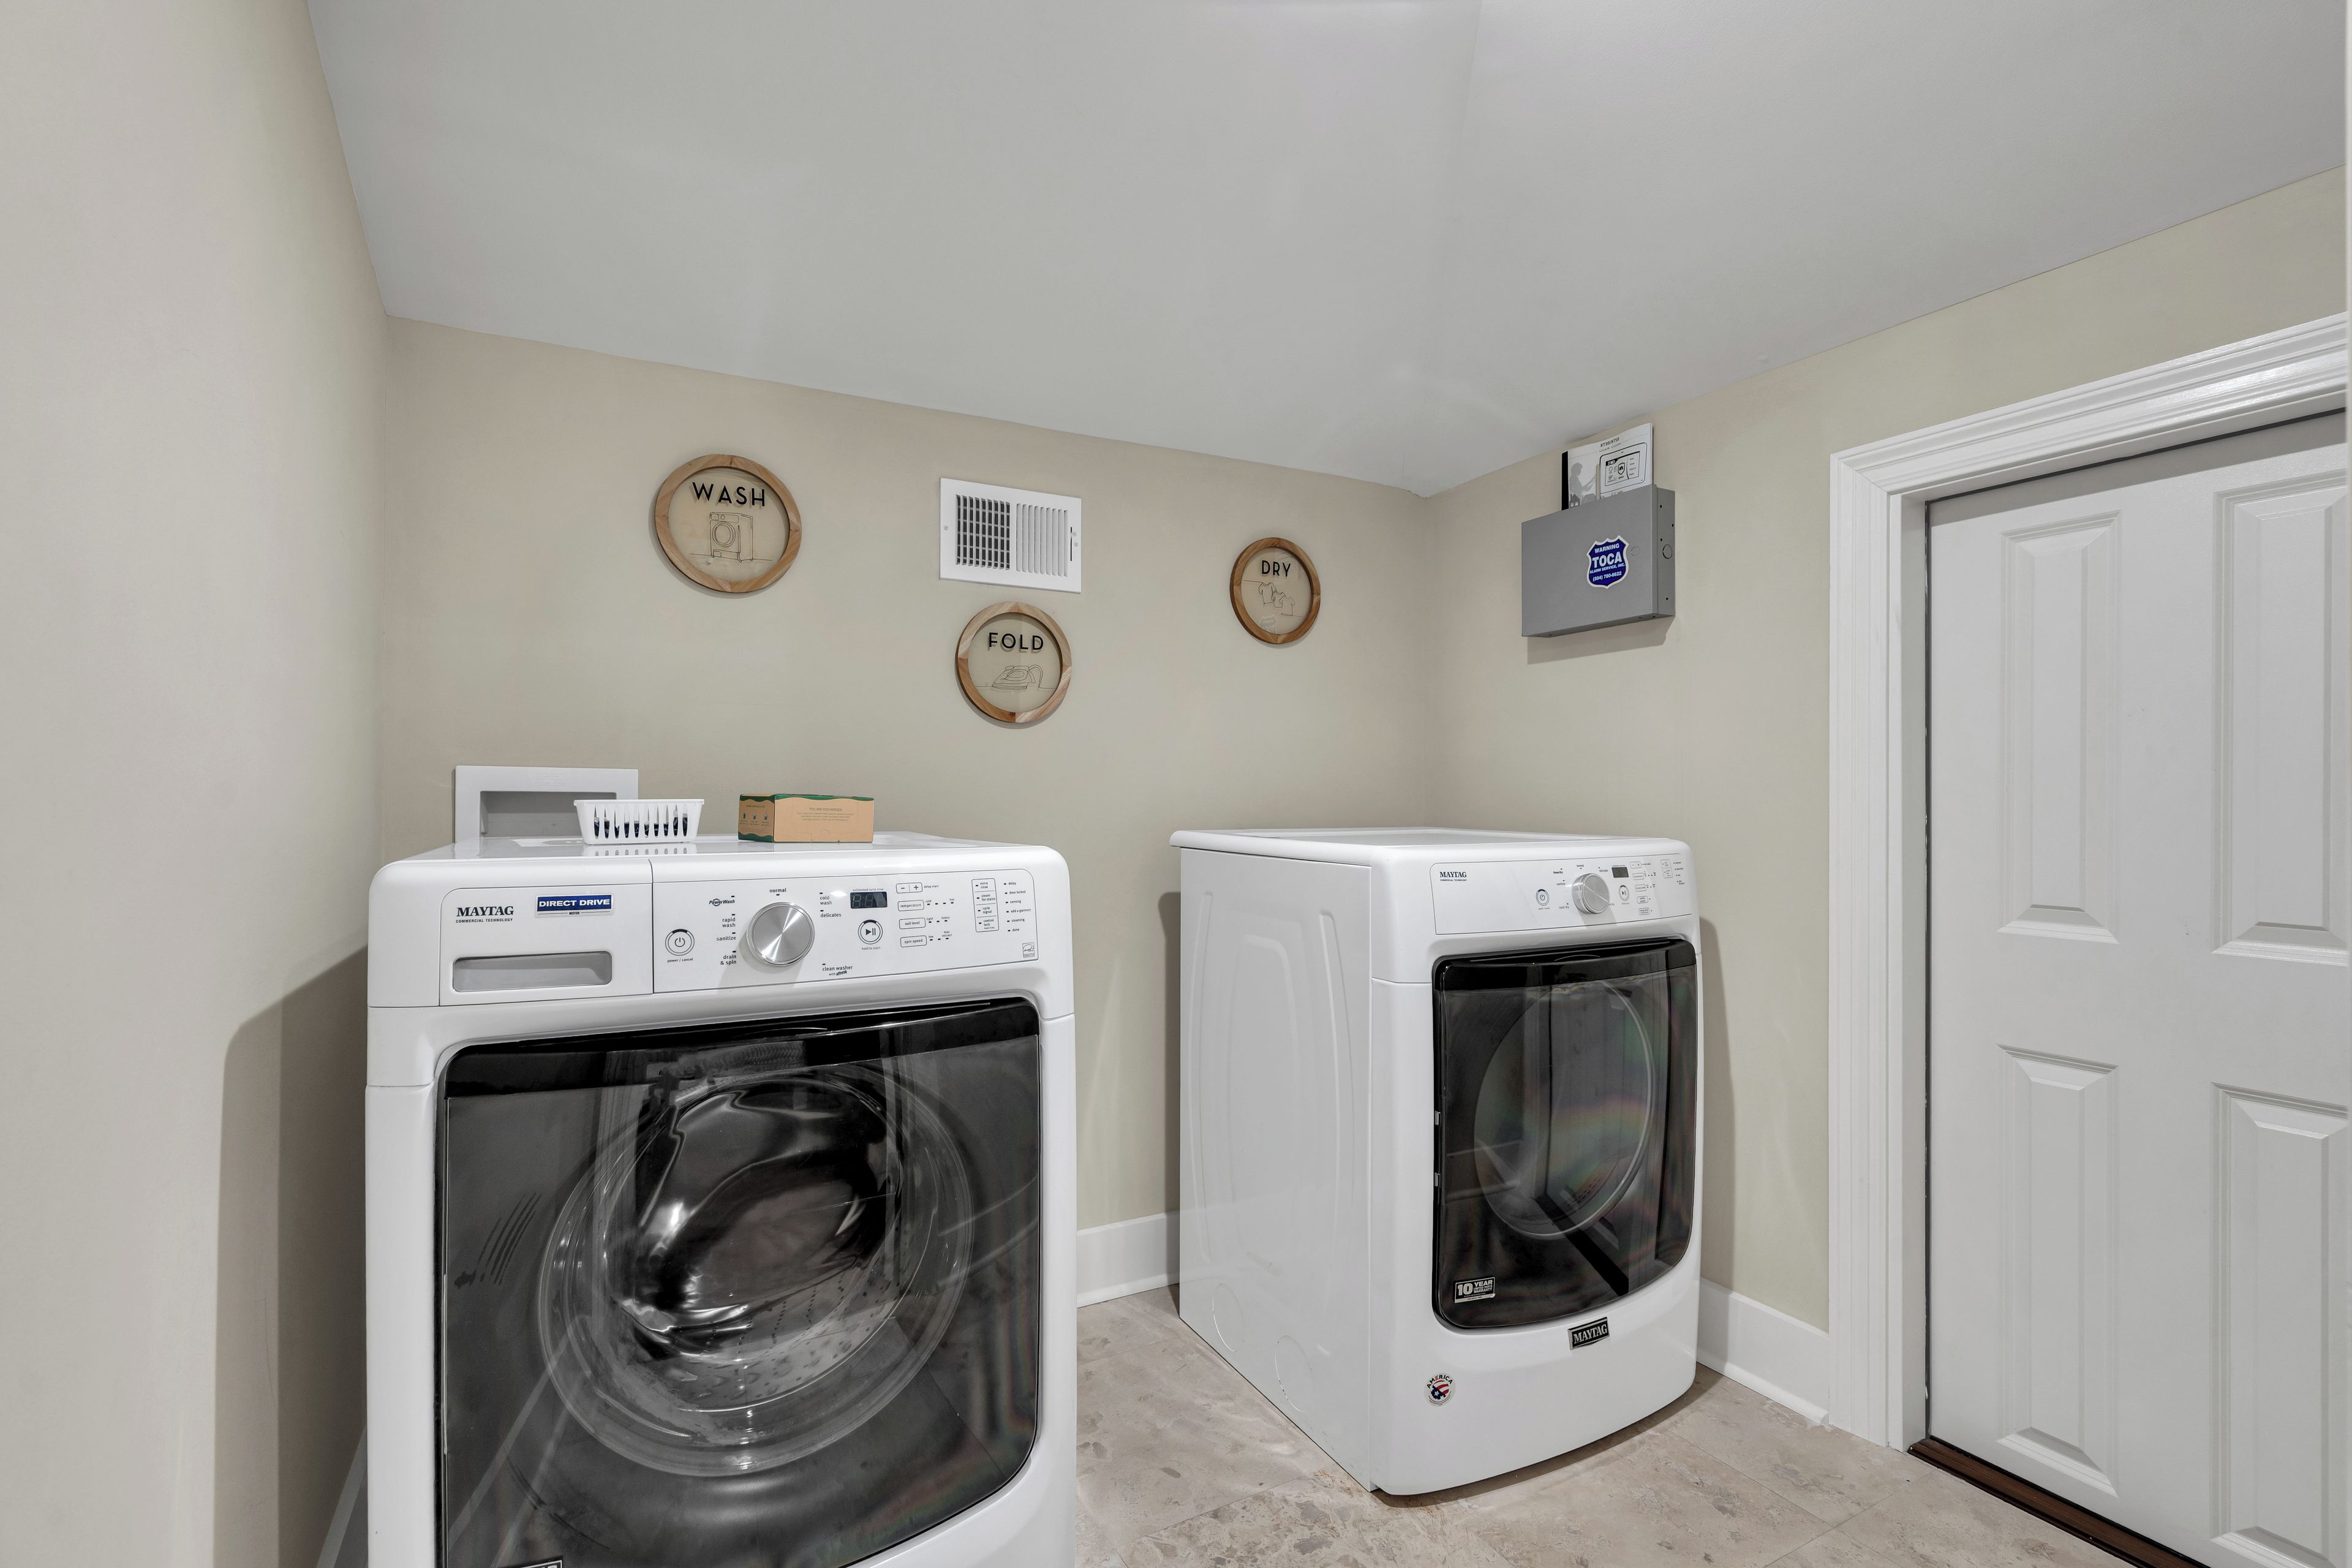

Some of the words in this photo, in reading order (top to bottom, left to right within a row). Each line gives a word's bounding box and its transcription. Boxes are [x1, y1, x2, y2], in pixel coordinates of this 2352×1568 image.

[692, 482, 765, 507] WASH
[1594, 543, 1619, 553] WARNING
[1593, 551, 1623, 568] TOCA
[1262, 560, 1291, 577] DRY
[989, 632, 1044, 650] FOLD
[456, 905, 514, 917] MAYTAG
[1458, 1283, 1473, 1295] 10
[1574, 1324, 1607, 1344] MAYTAG
[1427, 1374, 1453, 1389] AMERICA
